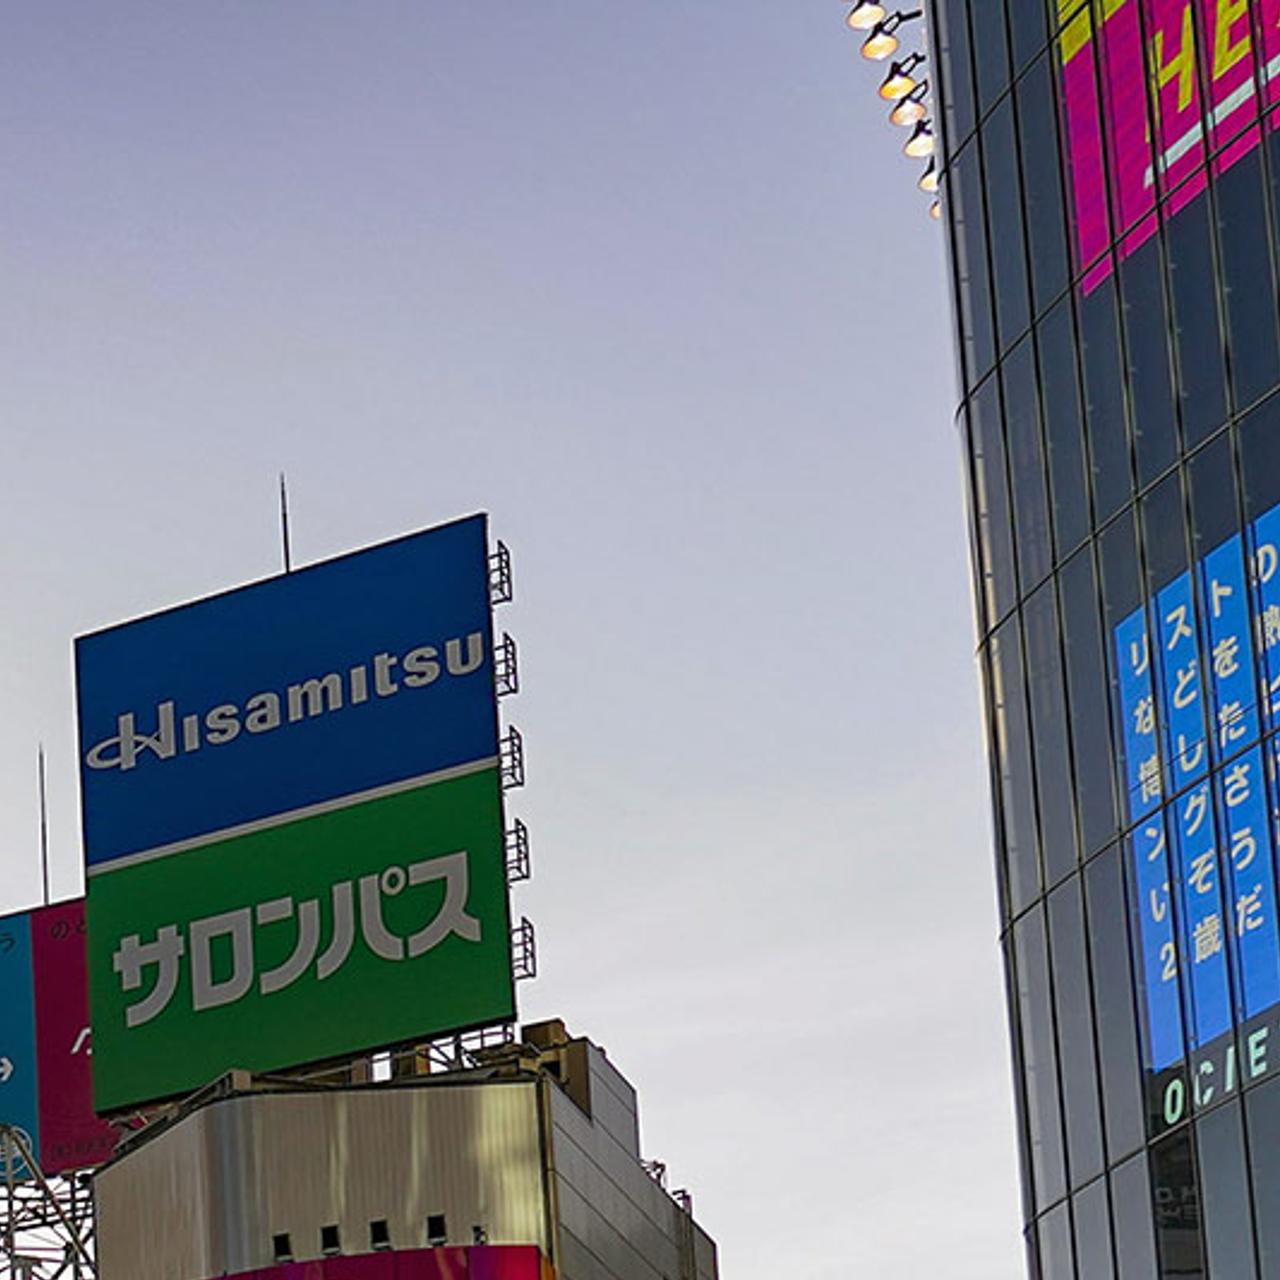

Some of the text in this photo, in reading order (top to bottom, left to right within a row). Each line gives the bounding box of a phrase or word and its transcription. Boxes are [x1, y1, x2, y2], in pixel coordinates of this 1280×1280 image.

[86, 632, 484, 770] Hisamitsu
[113, 851, 482, 1028] サロンパス
